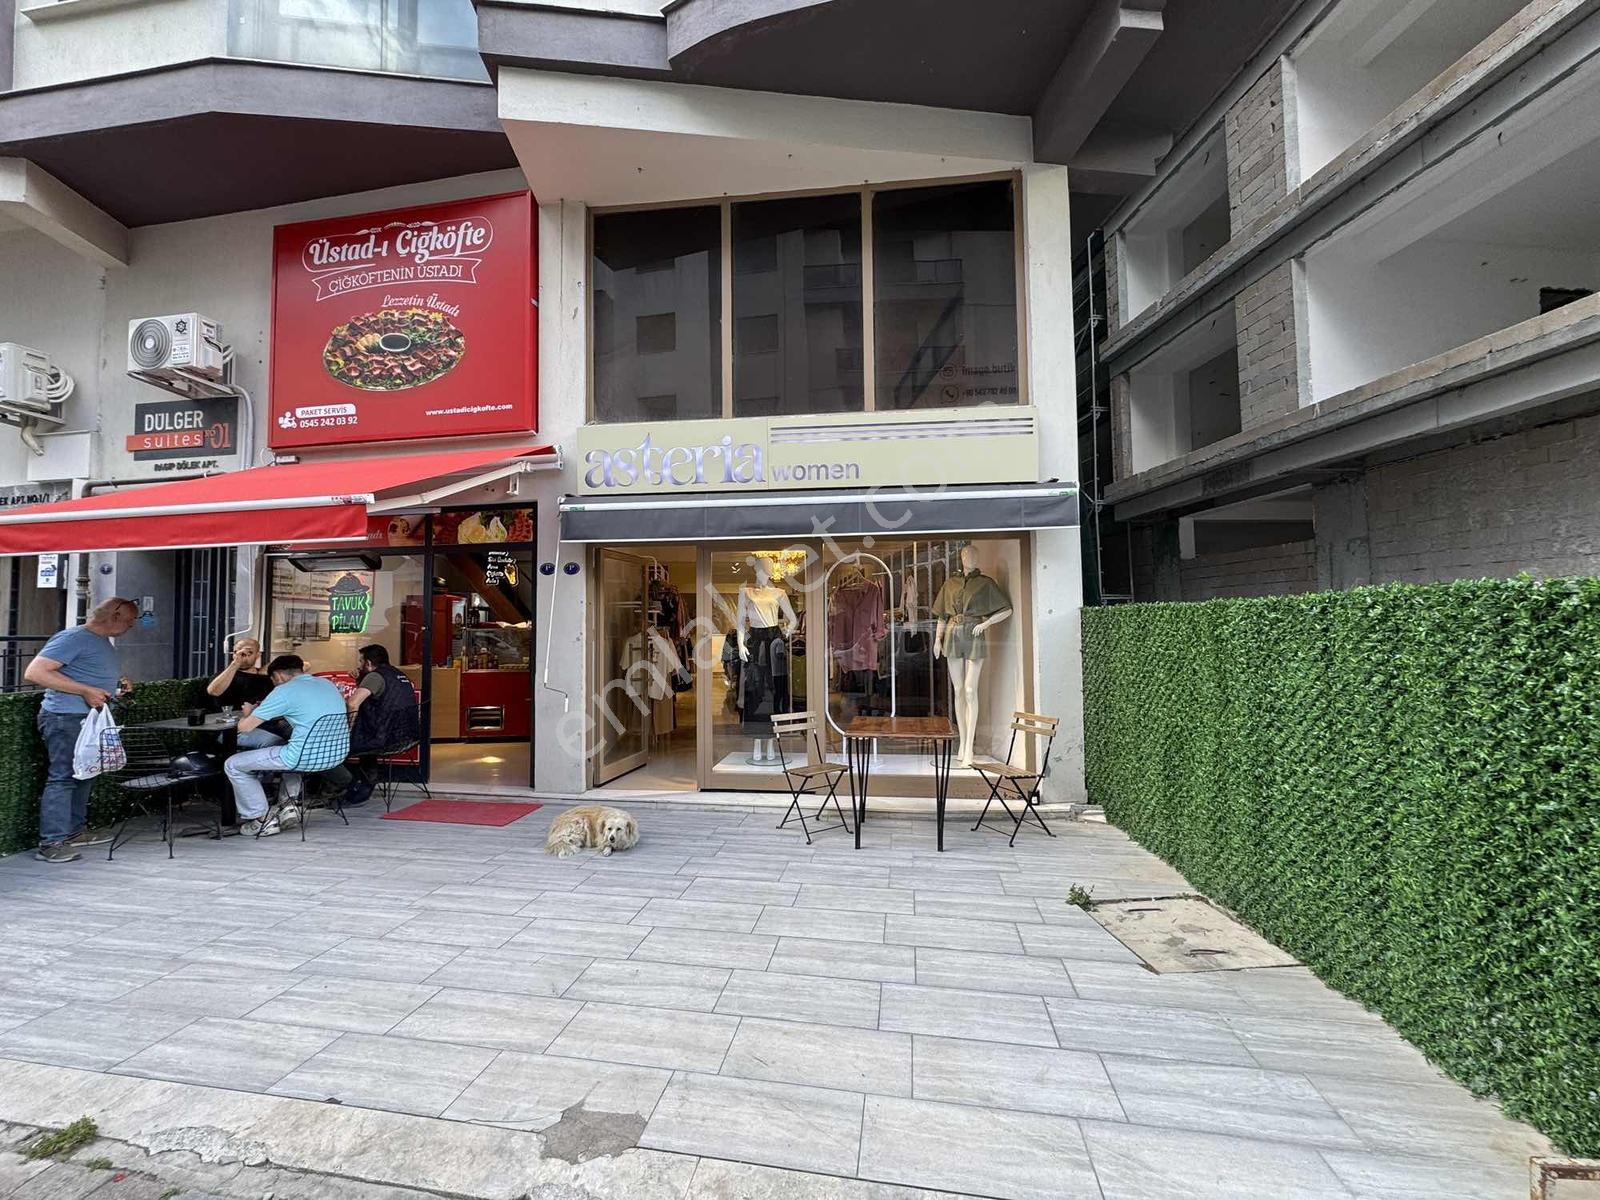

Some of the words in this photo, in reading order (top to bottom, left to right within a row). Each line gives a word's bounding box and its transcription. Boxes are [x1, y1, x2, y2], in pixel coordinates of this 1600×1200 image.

[309, 235, 388, 265] Üstad-ı
[396, 222, 486, 263] Çiğköfte
[418, 263, 463, 278] ÜSTADI
[382, 294, 424, 308] Lezzetin
[426, 293, 460, 317] Üstadı
[144, 410, 204, 432] DÜLGER
[300, 419, 319, 428] 0545
[320, 418, 335, 427] 242
[336, 417, 346, 426] 03
[347, 416, 358, 425] 92
[301, 408, 322, 417] PAKET
[144, 433, 201, 448] suites
[210, 422, 231, 449] 01
[584, 432, 766, 488] asteria
[771, 462, 860, 482] women
[332, 596, 364, 610] TAVUK
[331, 613, 363, 630] PİLAV
